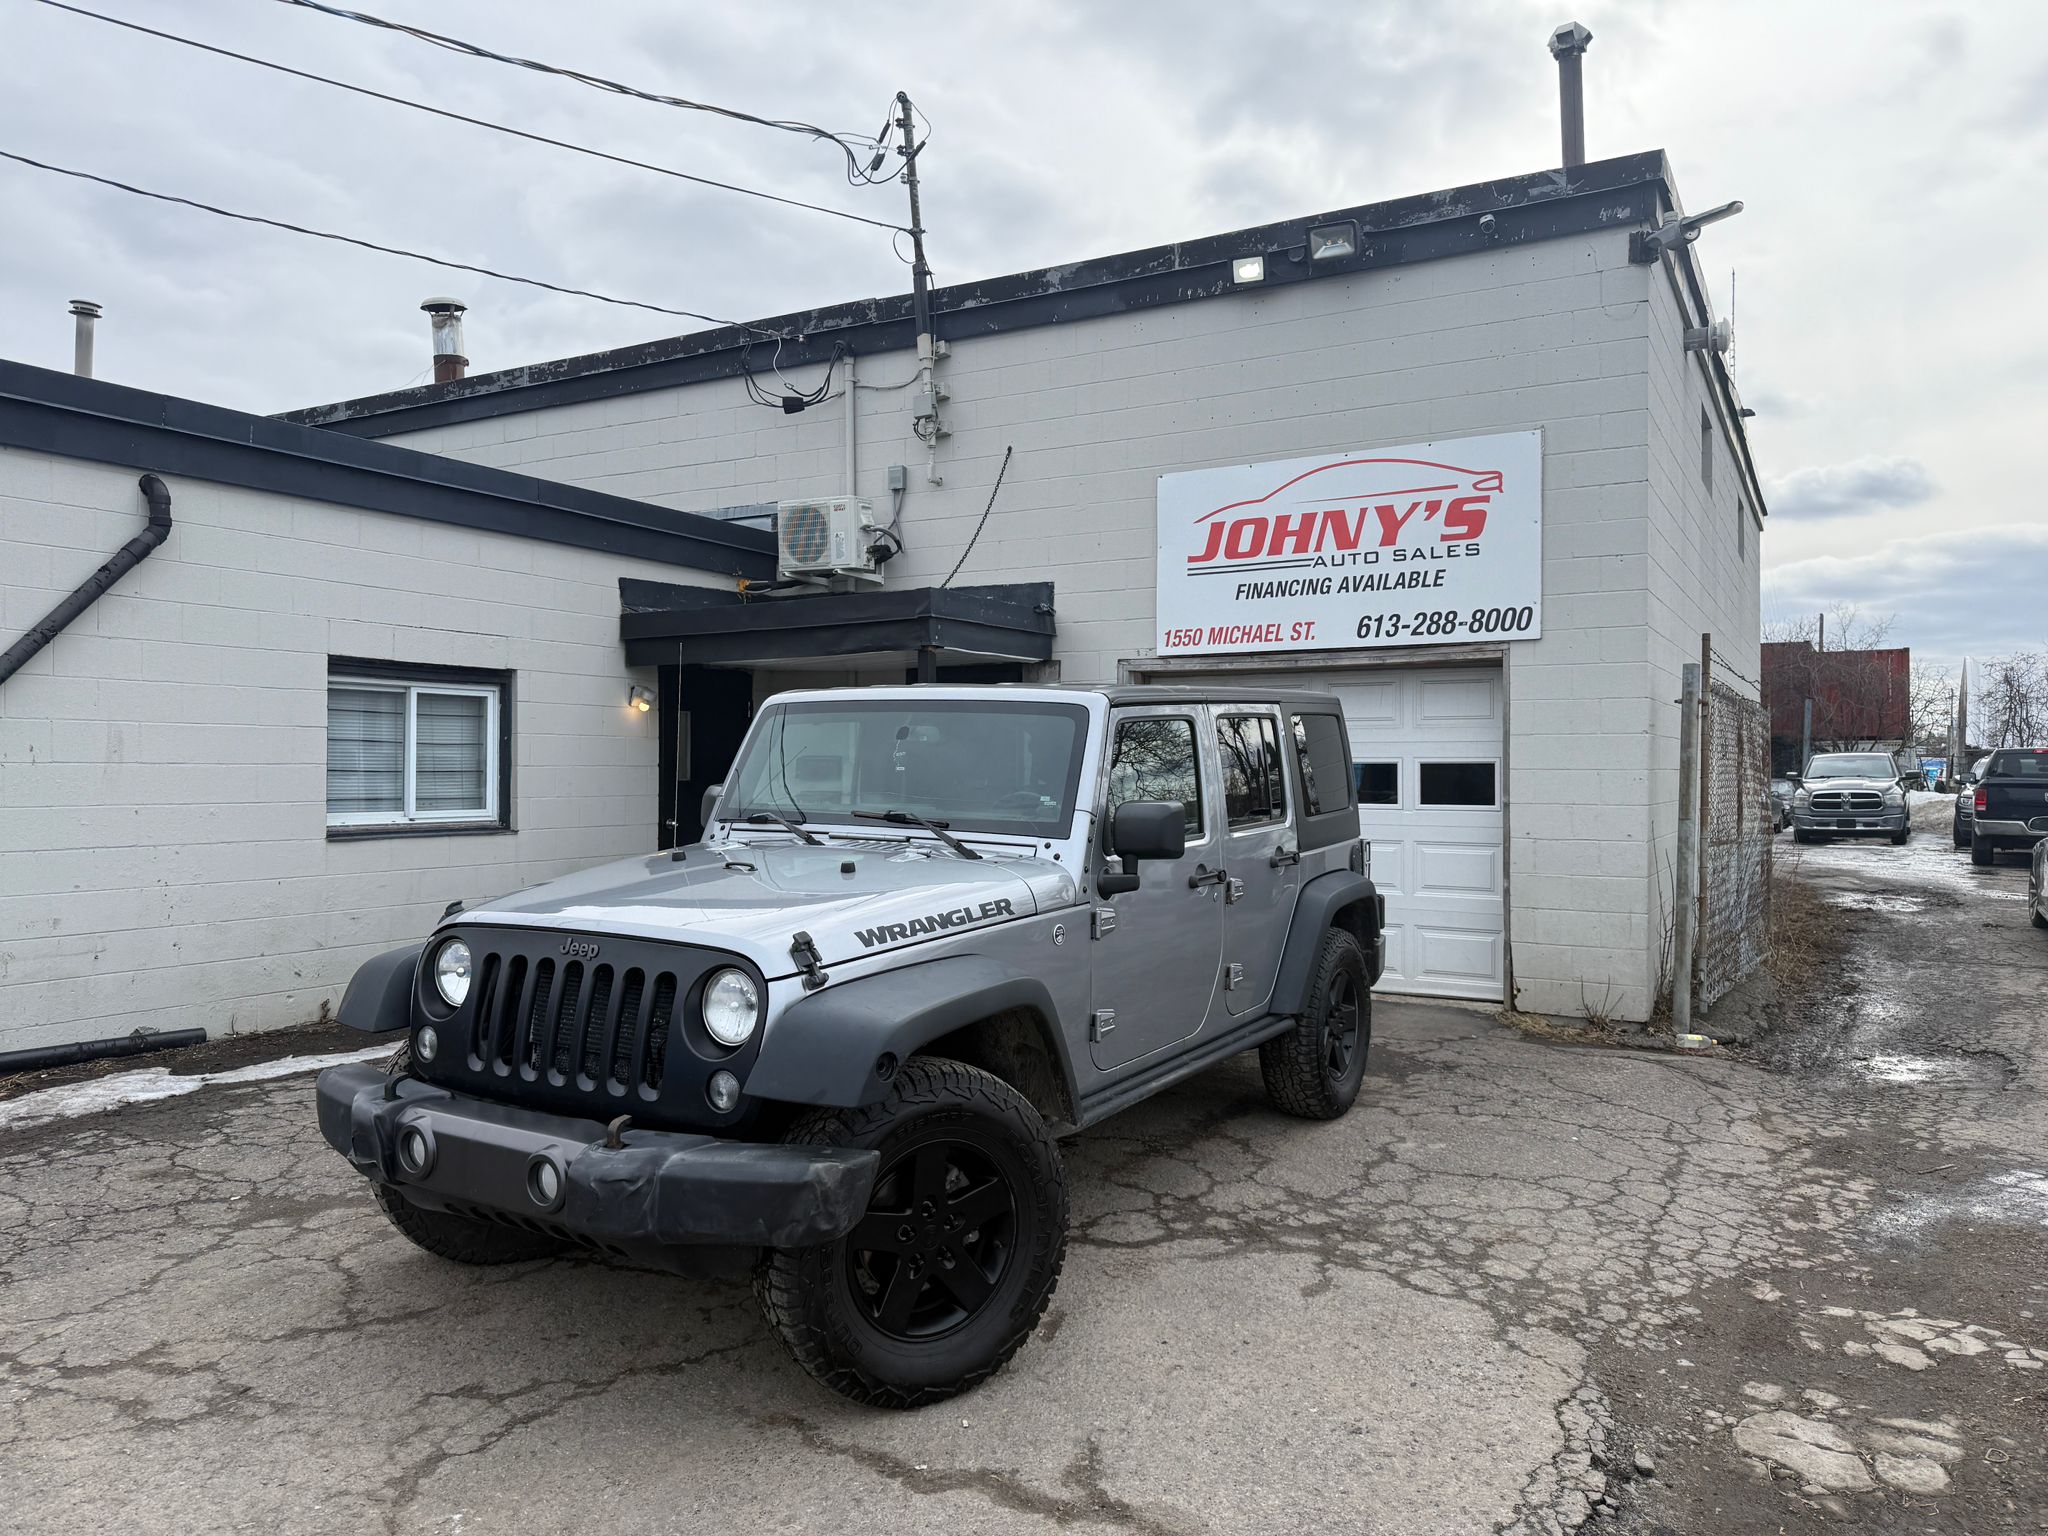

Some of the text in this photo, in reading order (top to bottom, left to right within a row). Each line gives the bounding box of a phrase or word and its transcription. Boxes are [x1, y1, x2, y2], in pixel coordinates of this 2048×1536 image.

[1187, 495, 1491, 564] JOHNY'S
[1313, 543, 1480, 569] AUTO SALES
[1235, 569, 1447, 601] FINANCING AVAILABLE
[1164, 621, 1316, 648] 1550 MICHAEL ST.
[1357, 606, 1534, 639] 613-288-8000
[854, 898, 1015, 948] WRANGLER
[560, 937, 600, 961] Jeep
